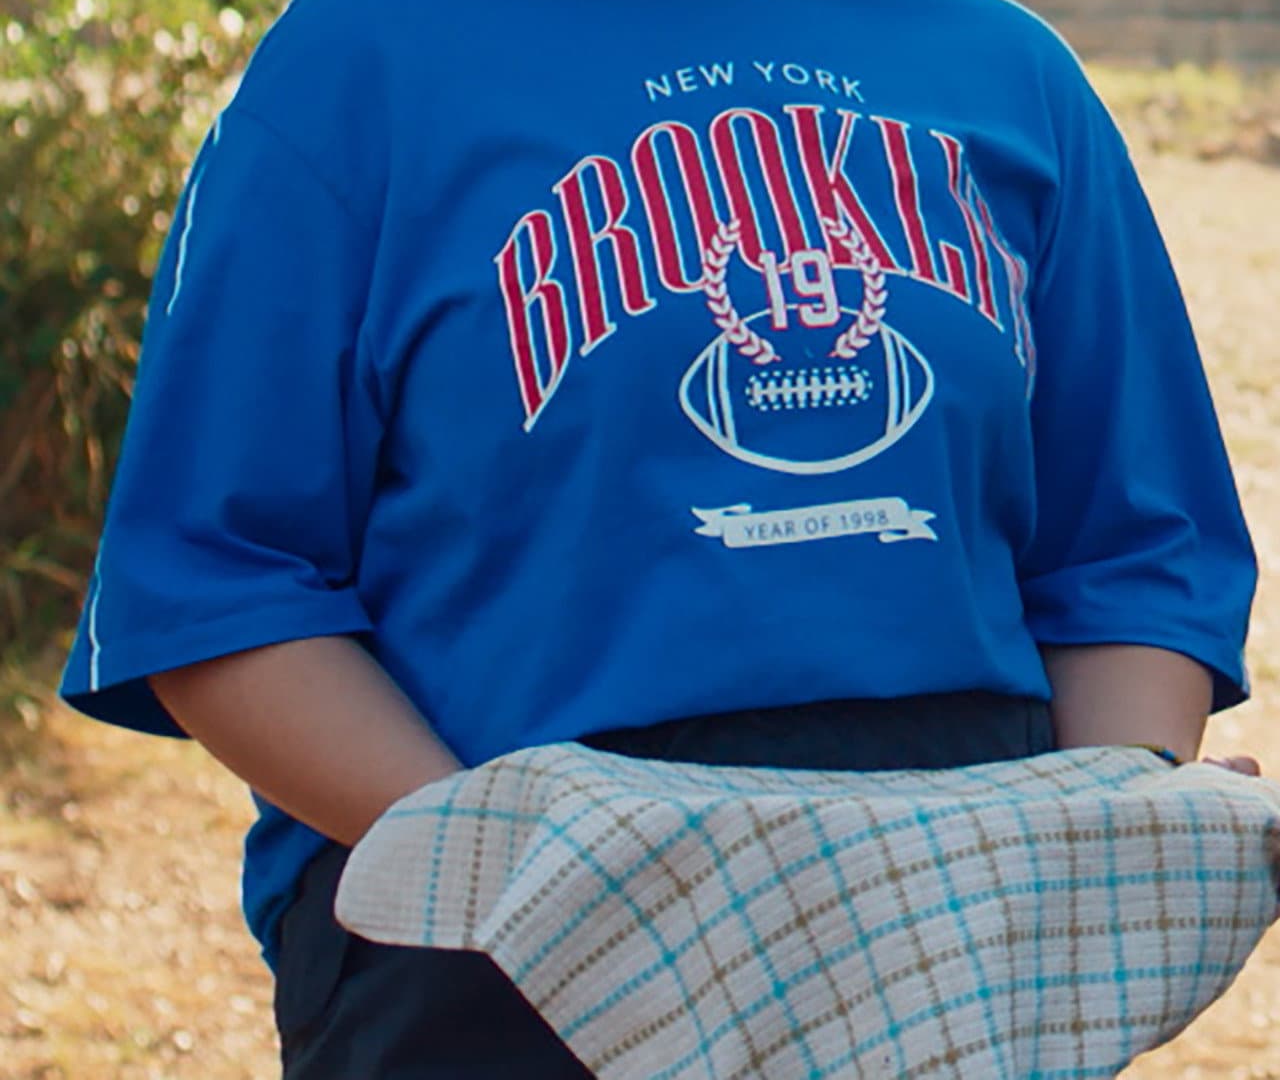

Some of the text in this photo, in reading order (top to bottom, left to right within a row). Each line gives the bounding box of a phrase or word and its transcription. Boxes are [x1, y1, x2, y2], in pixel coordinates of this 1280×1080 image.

[645, 60, 865, 103] NEW YORK
[758, 249, 841, 331] 19
[743, 509, 889, 541] YEAR OF 1998
